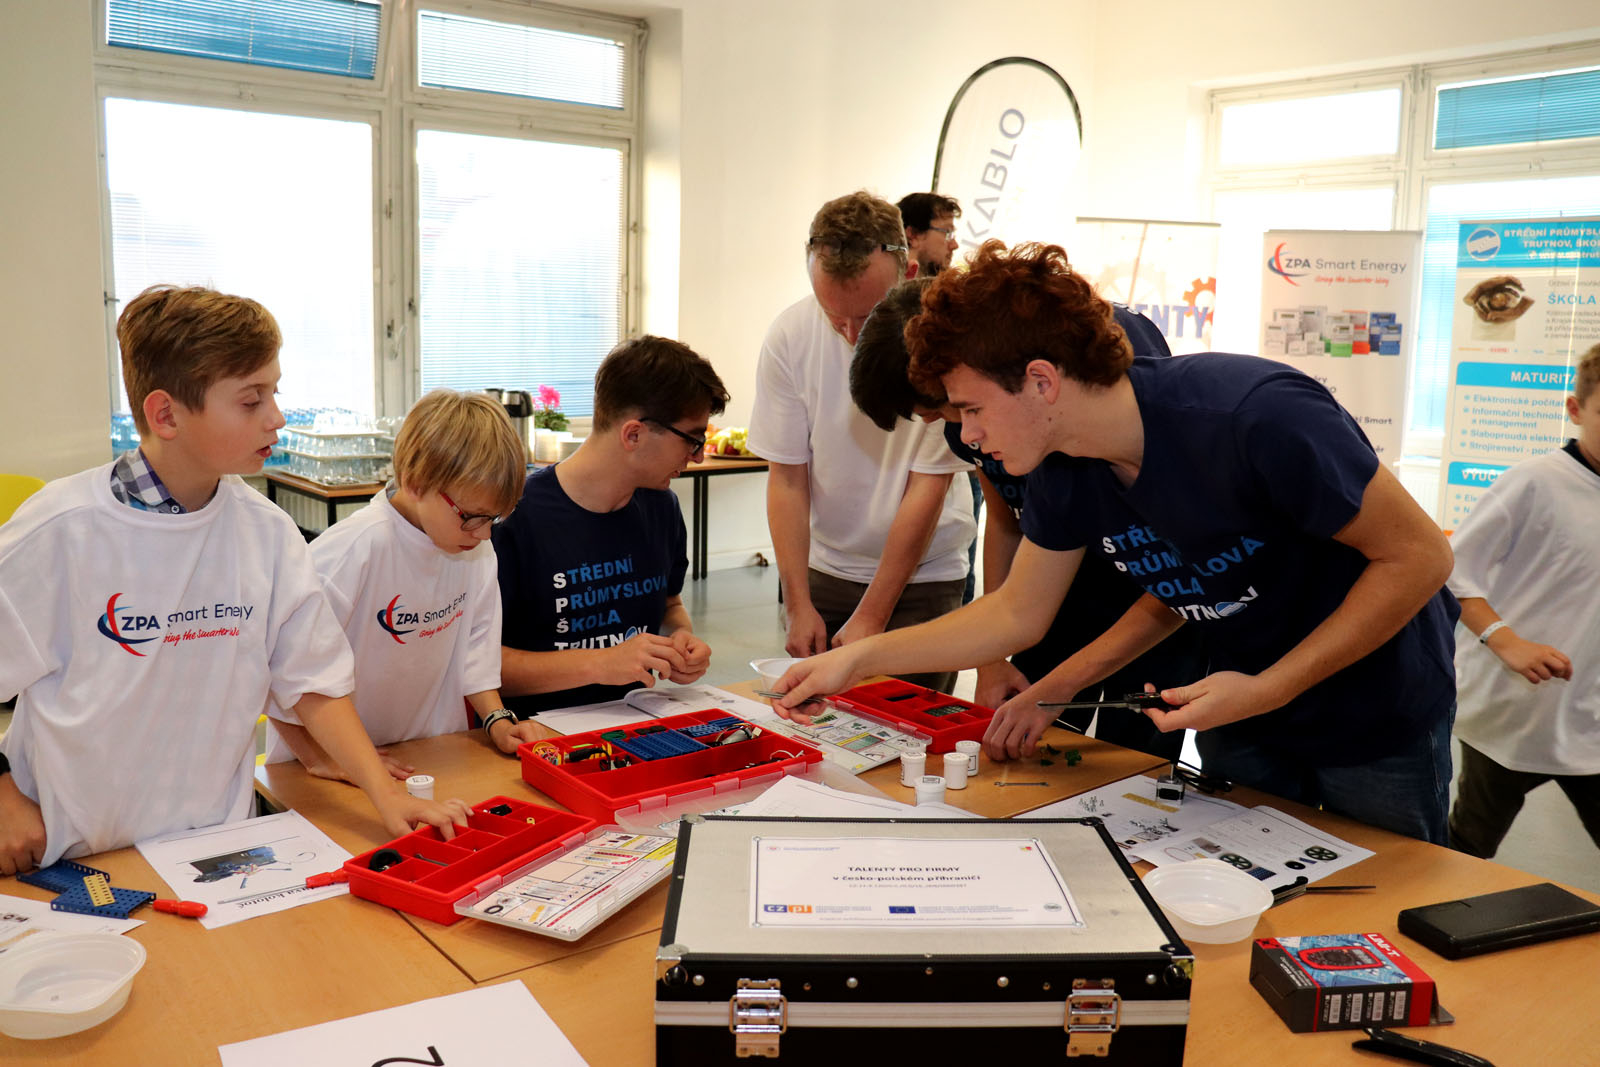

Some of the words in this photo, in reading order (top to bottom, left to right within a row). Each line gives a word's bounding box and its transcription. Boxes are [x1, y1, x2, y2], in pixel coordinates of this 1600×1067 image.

[961, 108, 1024, 250] KABLO
[1285, 258, 1311, 268] ZPA
[1315, 259, 1355, 270] Smart
[1360, 260, 1407, 273] Energy
[1547, 292, 1597, 305] ŠKOLA
[553, 554, 633, 589] STŘEDNÍ
[121, 615, 161, 631] ZPA
[396, 613, 419, 625] ZPA
[423, 604, 452, 623] Smart
[556, 609, 622, 634] ŠKOLA
